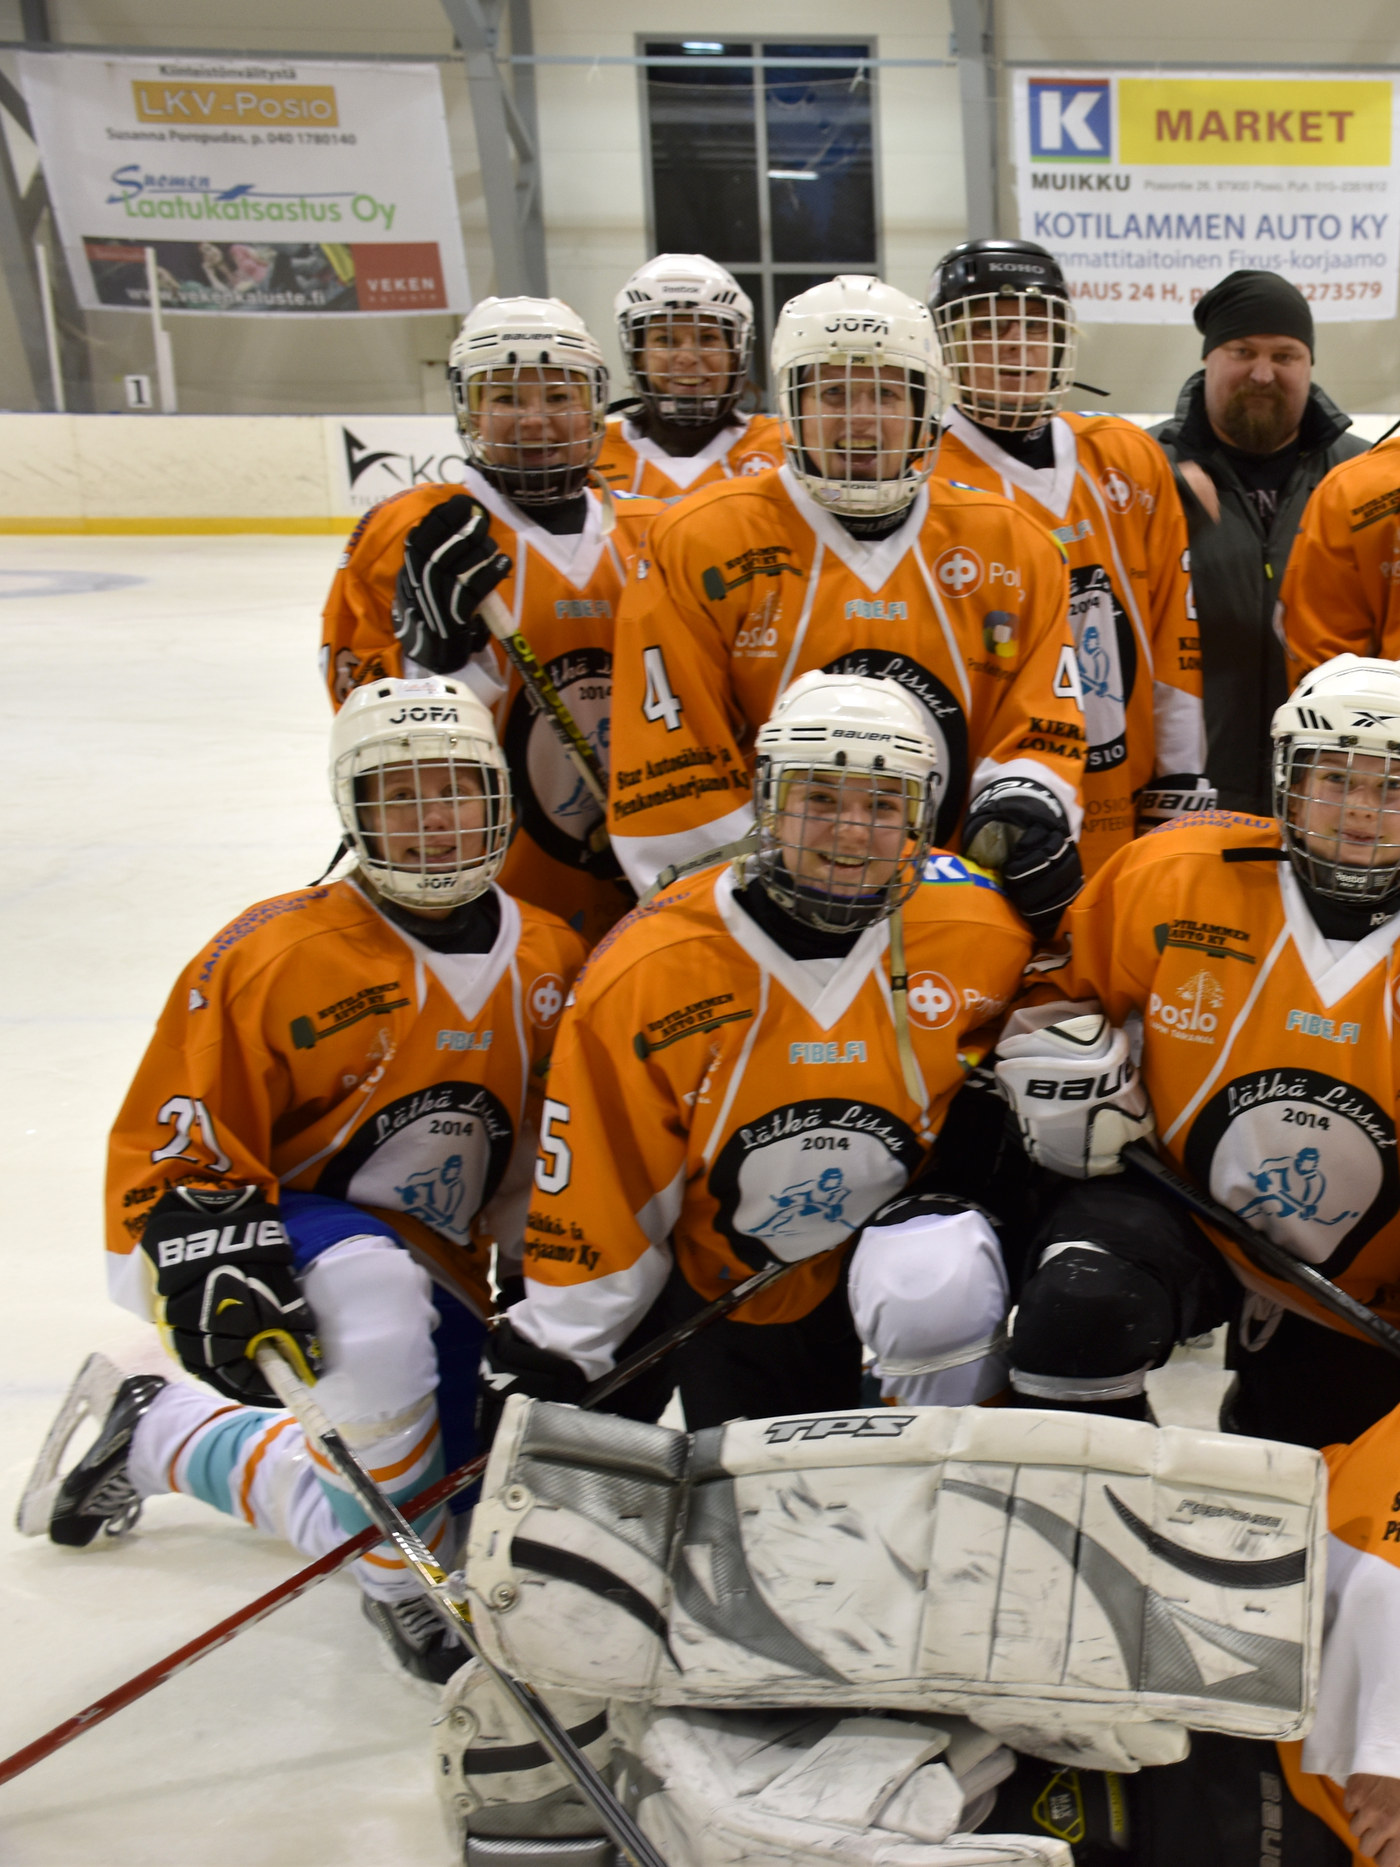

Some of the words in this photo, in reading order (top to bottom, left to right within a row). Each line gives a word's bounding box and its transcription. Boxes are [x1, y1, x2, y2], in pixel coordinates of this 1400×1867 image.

[1039, 90, 1103, 151] K
[1155, 109, 1355, 143] MARKET
[1031, 173, 1131, 192] MUIKKU
[123, 191, 342, 223] Laatukatsastus
[352, 194, 397, 231] Oy
[1034, 210, 1246, 241] KOTILAMMEN
[1255, 213, 1342, 241] AUTO
[1351, 213, 1390, 240] KY
[987, 261, 1046, 276] KOHO
[1050, 249, 1223, 270] mmattitaitoinen
[1228, 249, 1387, 274] Fixus-korjaamo
[368, 277, 435, 292] VEKEN
[1066, 281, 1123, 301] NAUS
[1129, 282, 1157, 301] 24
[1162, 283, 1184, 303] H,
[825, 317, 890, 336] JOFA
[130, 379, 147, 405] 1
[641, 645, 682, 732] 4
[1051, 645, 1086, 712] 4
[388, 708, 460, 725] JOFA
[831, 728, 892, 743] BAUER
[1015, 737, 1088, 762] LOMA
[1285, 1008, 1361, 1045] FIBE.FI
[788, 1042, 867, 1064] FIBE.FI
[1226, 1068, 1308, 1117] Lätkä
[1312, 1086, 1398, 1150] Lissut
[1280, 1107, 1331, 1132] 2014
[151, 1094, 232, 1174] 21
[428, 1120, 474, 1137] 2014
[739, 1107, 824, 1150] Lätkä
[533, 1097, 572, 1196] 5
[801, 1136, 851, 1151] 2014
[157, 1220, 291, 1268] BAUE
[764, 1413, 919, 1446] TPS
